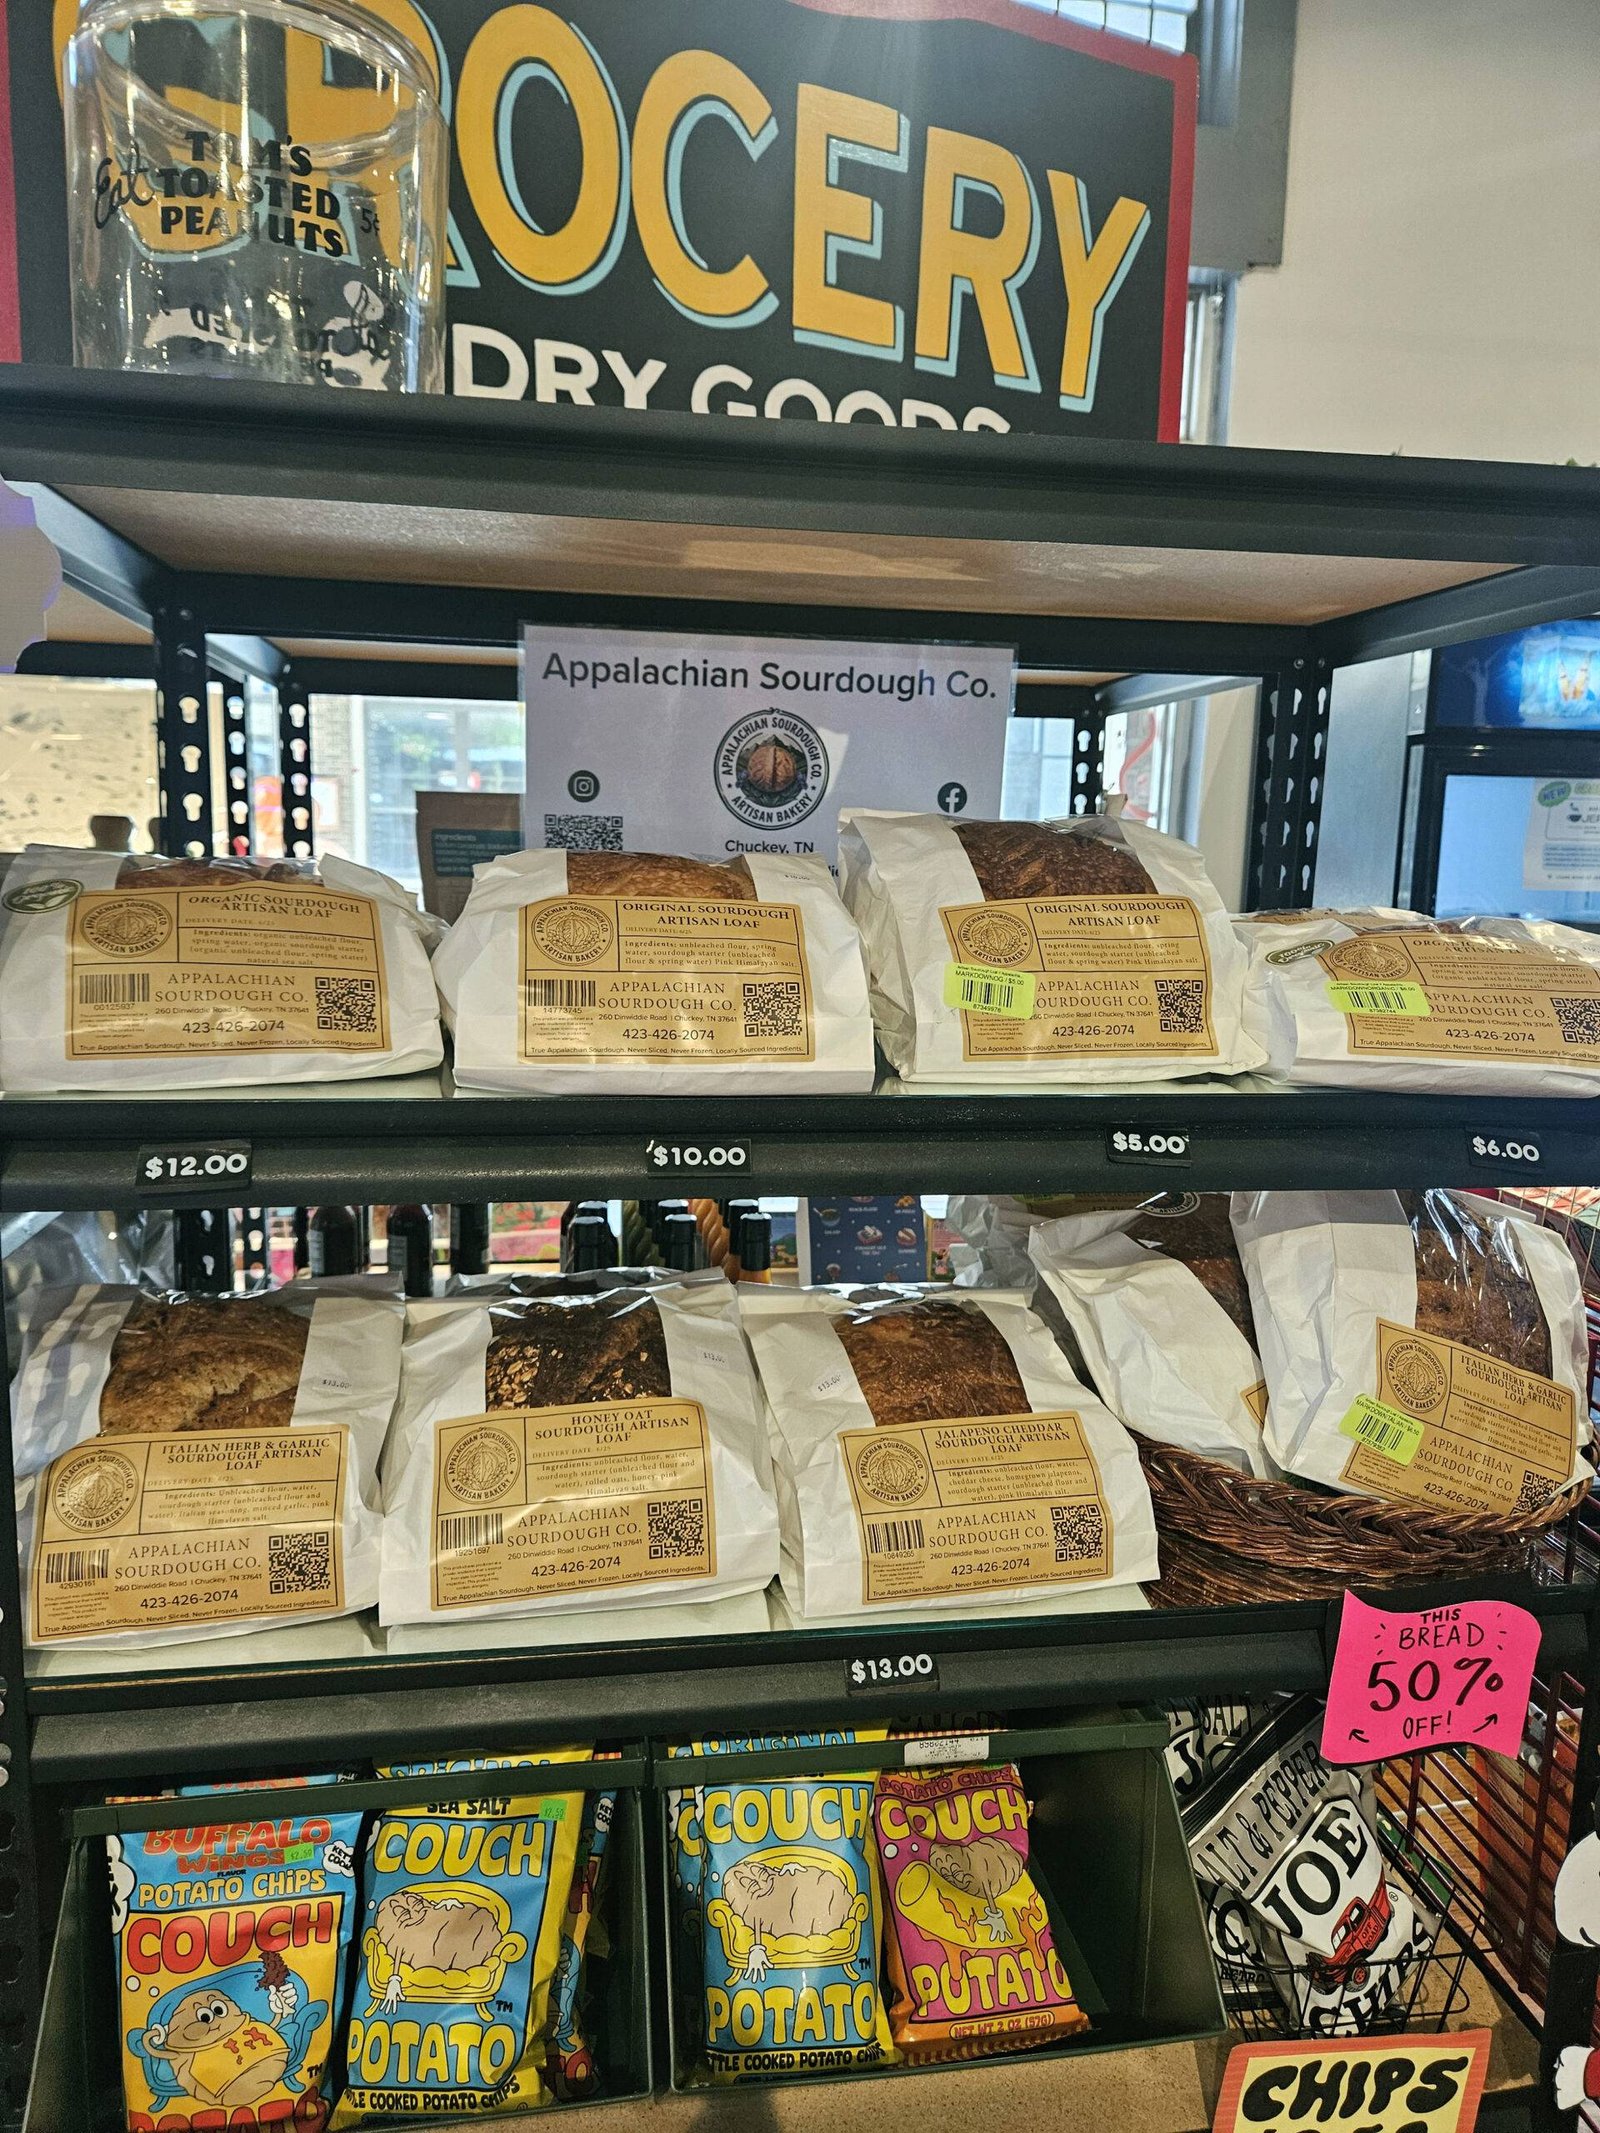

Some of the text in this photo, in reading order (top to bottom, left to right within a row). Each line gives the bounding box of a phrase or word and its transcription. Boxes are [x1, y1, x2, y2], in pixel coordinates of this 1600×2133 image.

[452, 323, 667, 409] DRY
[542, 652, 997, 702] Appalachian Sourdough Co.
[722, 717, 769, 776] APPALACHIAN
[772, 717, 821, 761] SOURDOUGH
[731, 792, 813, 823] ARTISAN BAKERY
[794, 841, 814, 854] TN
[188, 894, 360, 914] ORGANIC SOURDOUGH
[221, 902, 333, 918] ARTISAN LOAF
[623, 903, 789, 920] ORIGINAL SOURDOUGH
[1034, 902, 1185, 915] ORIGINAL SOURDOUGH
[657, 916, 760, 928] ARTISAN LOAF
[1068, 915, 1160, 927] ARTISAN LOAF
[168, 973, 296, 987] APPALACHIAN
[610, 982, 726, 994] APPALACHIAN
[1038, 980, 1140, 992] APPALACHIAN
[155, 989, 308, 1003] SOURDOUGH CO.
[598, 998, 737, 1011] SOURDOUGH CO.
[1034, 995, 1152, 1008] OURDOUGH CO.
[1425, 992, 1534, 1005] APPALACHIAN
[1429, 1004, 1550, 1018] OURDOUGH CO.
[182, 1020, 285, 1034] 423-426-2074
[622, 1028, 715, 1041] 423-426-2074
[1052, 1024, 1135, 1037] 423-426-2074
[1446, 1028, 1535, 1042] 423-426-2074
[1112, 1131, 1186, 1154] $5.00
[1472, 1135, 1541, 1163] $6.00
[145, 1153, 248, 1180] $12.00
[653, 1145, 746, 1167] $10.00
[1461, 1355, 1500, 1377] ITALIAN
[1536, 1384, 1567, 1405] GARLIC
[1465, 1367, 1562, 1412] SOURDOUGH ARTISAN
[1504, 1391, 1528, 1406] LOAF
[535, 1417, 690, 1440] SOURDOUGH ARTISAN
[572, 1410, 653, 1426] HONEY OAT
[596, 1432, 631, 1445] LOAF
[935, 1431, 1071, 1449] SOURDOUGH ARTISAN
[937, 1422, 1063, 1440] JALAPENO CHEDDAR
[162, 1438, 331, 1455] ITALIAN HERB & GARLIC
[167, 1448, 323, 1464] SOURDOUGH ARTISAN
[991, 1443, 1023, 1454] LOAF
[1430, 1436, 1513, 1475] APPALACHIAN
[226, 1460, 263, 1471] LOAF
[1417, 1448, 1515, 1493] SOURDOUGH CO.
[1423, 1482, 1490, 1511] 423-426-2074
[517, 1505, 631, 1528] APPALACHIAN
[937, 1509, 1037, 1529] APPALACHIAN
[507, 1522, 642, 1548] SOURDOUGH CO.
[929, 1526, 1049, 1547] SOURDOUGH CO.
[128, 1537, 251, 1559] APPALACHIAN
[115, 1557, 261, 1580] SOURDOUGH CO.
[531, 1555, 621, 1577] 423-426-2074
[951, 1557, 1030, 1576] 423-426-2074
[140, 1589, 239, 1610] 423-426-2074
[1420, 1608, 1462, 1625] THIS
[1399, 1622, 1485, 1649] BREAD
[851, 1653, 933, 1684] $13.00
[1367, 1656, 1504, 1712] 50%
[1403, 1715, 1453, 1739] OFF!
[879, 1776, 954, 1800] POTATO
[1251, 1740, 1330, 1842] PEPPER
[466, 1797, 511, 1816] SALT
[703, 1787, 868, 1844] COUCH
[877, 1787, 1029, 1840] COUCH
[143, 1818, 332, 1855] BUFFALO
[1234, 1812, 1274, 1860] &
[373, 1820, 545, 1878] COUCH
[1194, 1823, 1259, 1893] ALT
[1261, 1806, 1367, 1938] JOE
[139, 1877, 244, 1908] POTATO
[125, 1901, 333, 1975] COUCH
[1361, 1923, 1373, 1939] OFF
[1364, 1924, 1379, 1949] ROAD
[910, 1947, 1074, 2018] POTATO
[706, 1980, 878, 2047] POTATO
[348, 2019, 516, 2085] POTATO
[744, 2052, 795, 2071] COOKED
[800, 2050, 853, 2068] POTATO
[1241, 2056, 1469, 2123] CHIPS
[370, 2092, 418, 2110] COOKED
[423, 2093, 477, 2110] POTATO
